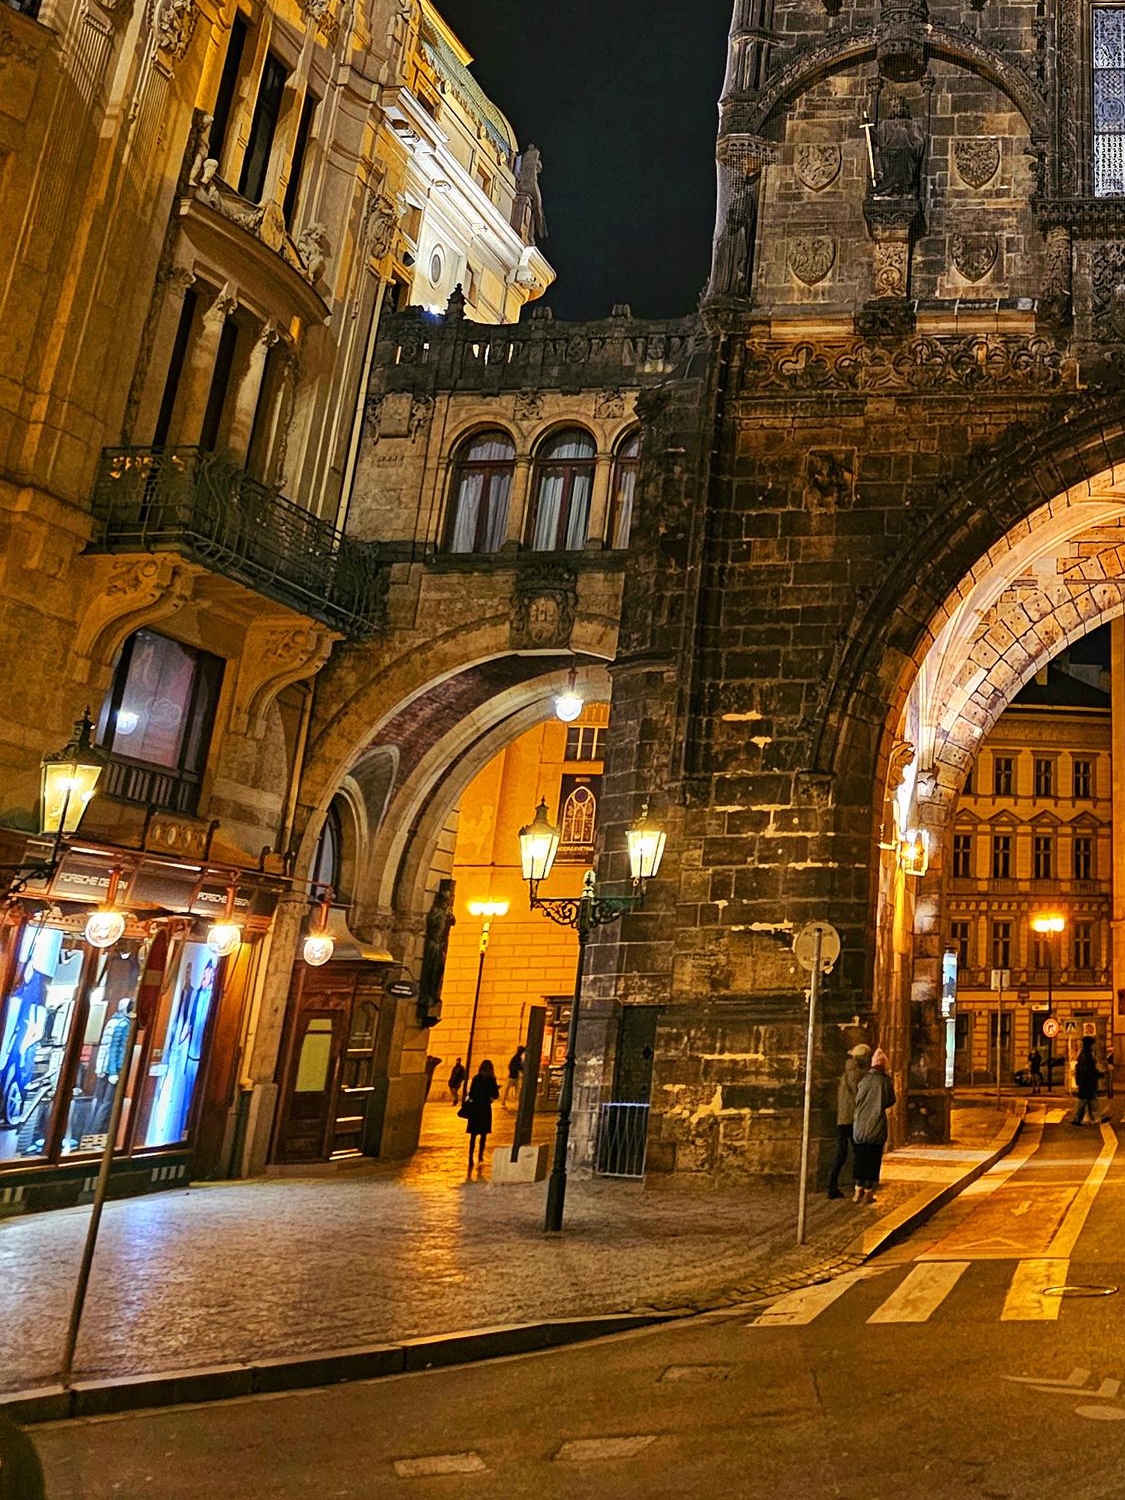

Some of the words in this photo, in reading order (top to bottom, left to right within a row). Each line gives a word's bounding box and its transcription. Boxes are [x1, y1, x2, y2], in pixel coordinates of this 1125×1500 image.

[60, 873, 98, 886] PORSCHE
[99, 878, 128, 889] DEGN
[197, 892, 228, 904] PORSCHE
